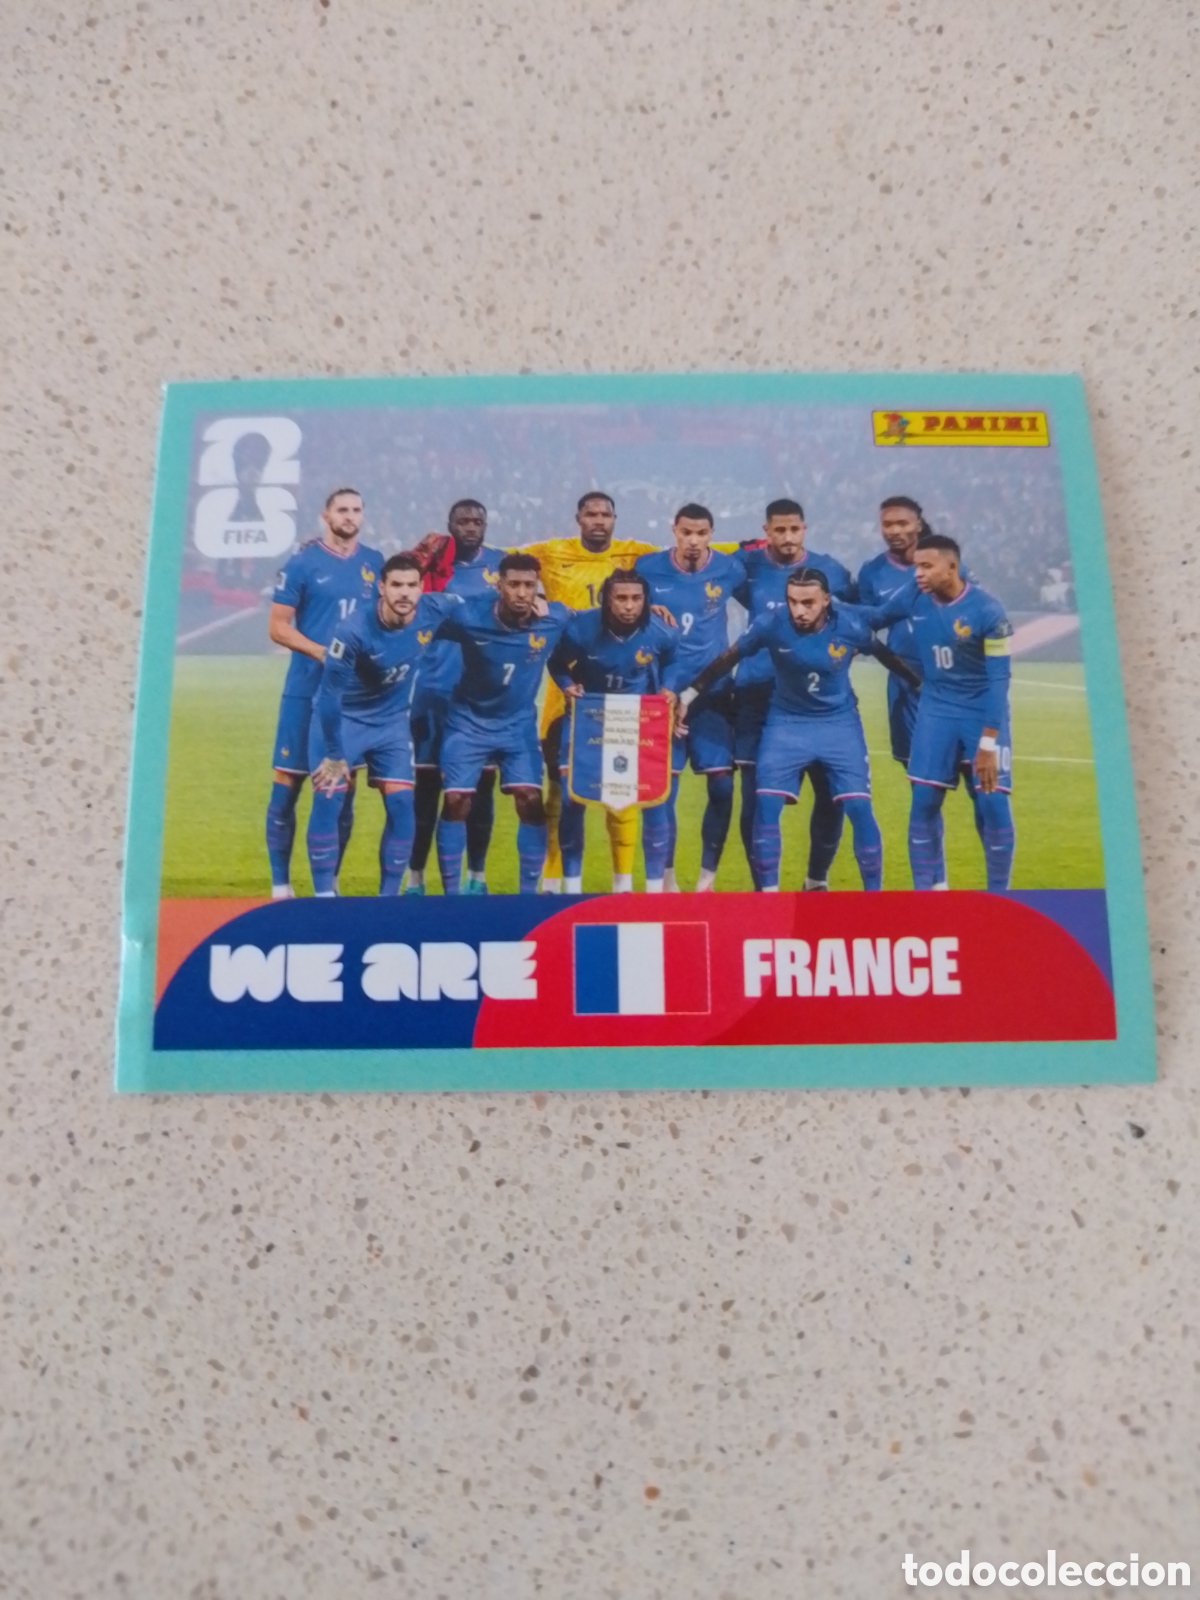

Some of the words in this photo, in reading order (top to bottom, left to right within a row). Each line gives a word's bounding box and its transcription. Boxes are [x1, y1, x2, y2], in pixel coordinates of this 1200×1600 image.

[921, 415, 1040, 433] PANINI
[222, 528, 269, 546] FIFA
[681, 612, 694, 636] 9
[931, 644, 954, 670] 10
[381, 663, 411, 685] 22
[502, 662, 516, 686] 7
[807, 672, 821, 693] 2
[209, 943, 345, 1003] WE
[361, 940, 538, 1002] ARE
[742, 936, 962, 998] FRANCE
